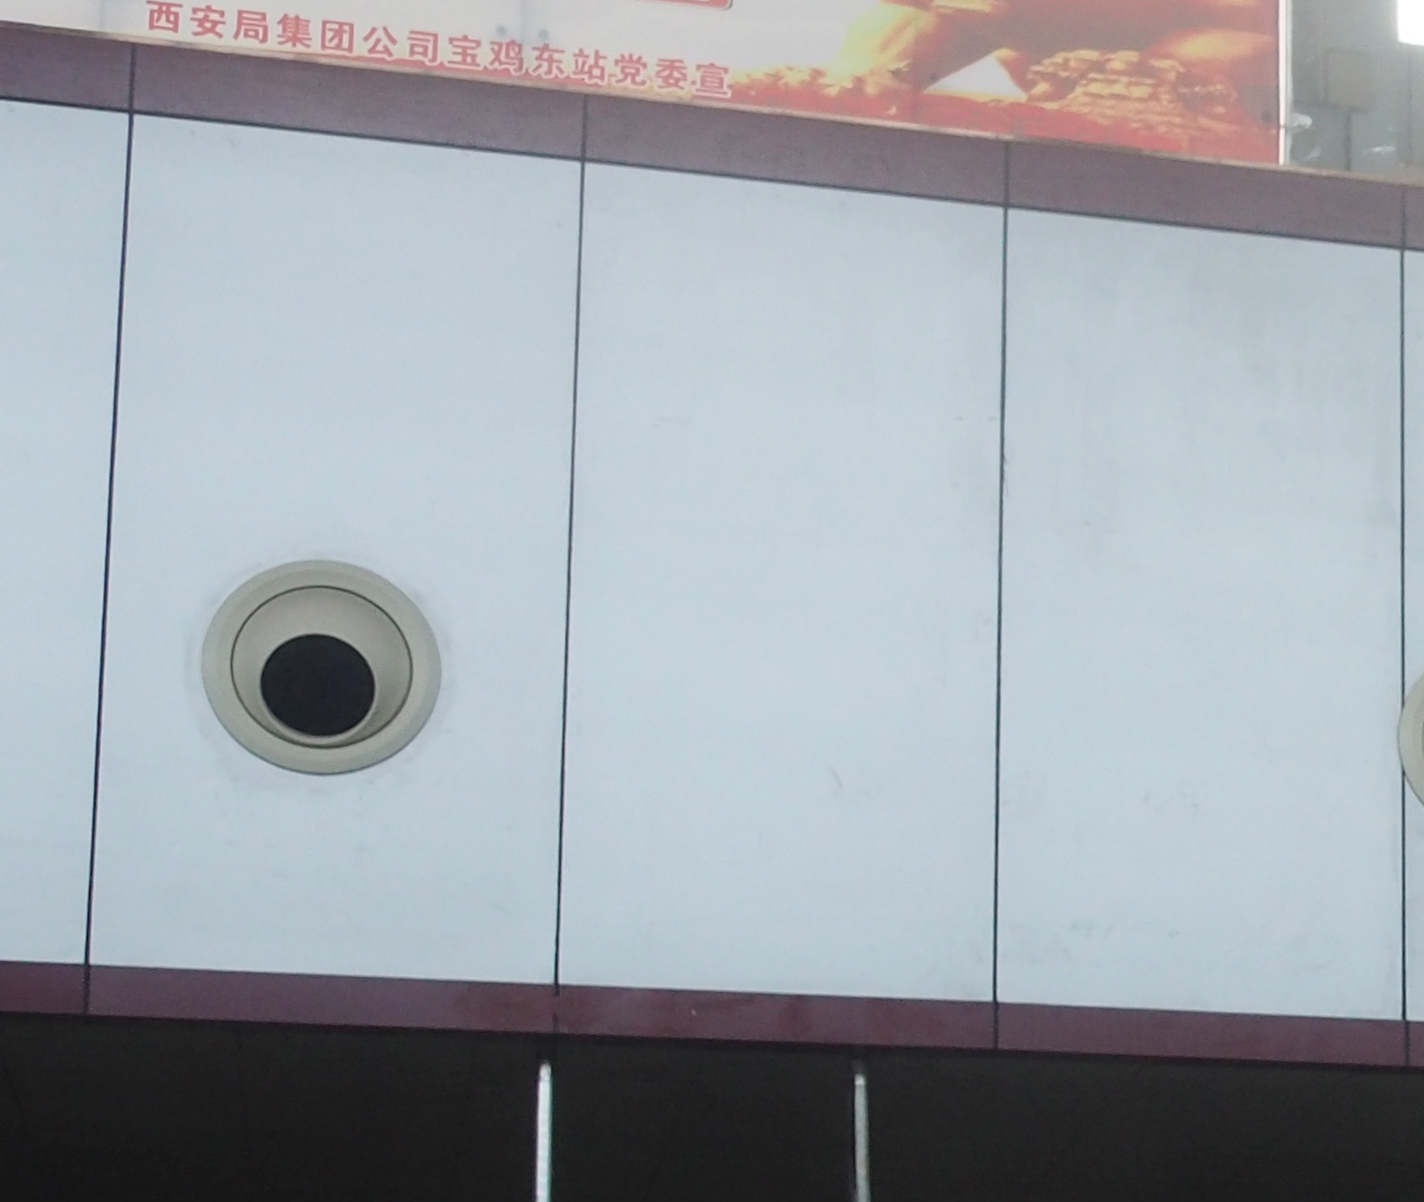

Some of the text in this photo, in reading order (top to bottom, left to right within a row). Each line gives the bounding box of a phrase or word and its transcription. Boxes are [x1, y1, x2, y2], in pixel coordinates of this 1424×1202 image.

[147, 1, 732, 99] 西安局集团公司宝鸡东站党委宣
